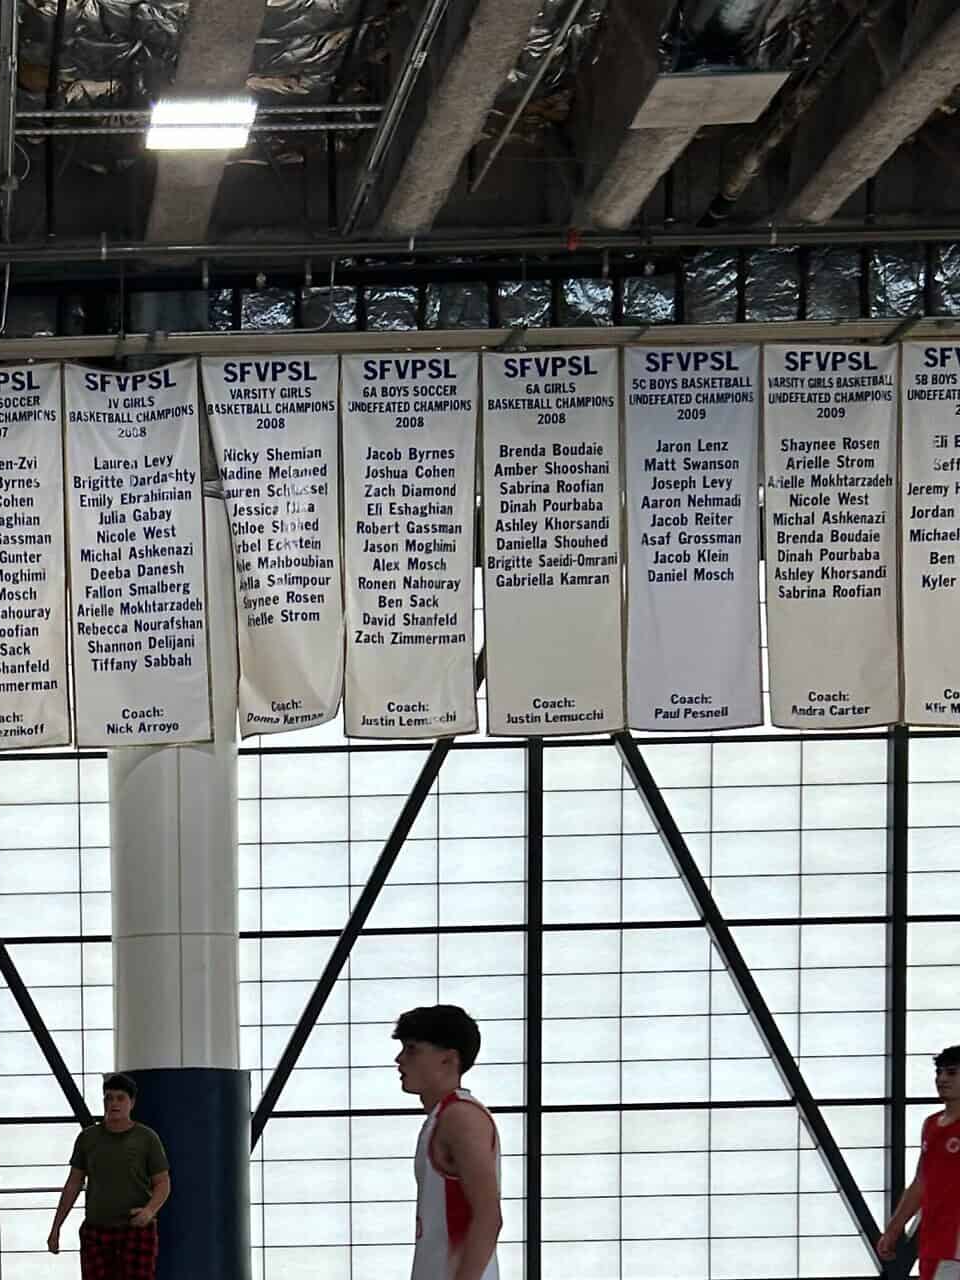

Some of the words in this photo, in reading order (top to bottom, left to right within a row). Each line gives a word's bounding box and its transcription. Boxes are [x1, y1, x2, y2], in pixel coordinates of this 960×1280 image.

[504, 356, 598, 378] SFVPSL
[646, 351, 738, 372] SFVPSL
[784, 352, 878, 371] SFVPSL
[224, 361, 317, 382] SFVPSL
[364, 359, 456, 380] SFVPSL
[85, 369, 176, 391] SFVPSL
[632, 379, 646, 389] 5C
[650, 378, 678, 390] BOYS
[682, 377, 752, 389] BASKETBALL
[915, 374, 928, 385] 5B
[932, 374, 957, 384] BOYS
[230, 388, 276, 399] VARSITY
[280, 387, 311, 398] GIRLS
[363, 387, 377, 397] 6A
[381, 386, 409, 397] BOYS
[413, 385, 456, 396] SOCCER
[526, 384, 540, 394] 6A
[544, 382, 576, 394] GIRLS
[123, 396, 154, 408] GIRLS
[488, 399, 552, 410] BASKETBALL
[556, 396, 614, 408] CHAMPIONS
[629, 394, 692, 405] UNDEFEATED
[695, 392, 754, 404] CHAMPIONS
[538, 413, 566, 424] 2008
[677, 409, 706, 420] 2009
[817, 407, 845, 418] 2009
[256, 418, 285, 429] 2008
[396, 417, 424, 428] 2008
[656, 440, 691, 452] Jaron
[698, 439, 728, 452] Lenz
[781, 439, 836, 453] Shaynee
[843, 437, 879, 449] Rosen
[224, 449, 259, 463] Nicky
[267, 448, 321, 461] Shemian
[366, 447, 401, 460] Jacob
[409, 448, 454, 462] Byrnes
[494, 463, 538, 476] Amber
[545, 461, 609, 474] Shooshani
[645, 458, 676, 471] Matt
[684, 458, 739, 470] Swanson
[364, 484, 395, 497] Zach
[402, 484, 456, 497] Diamond
[907, 483, 949, 497] Jeremy
[500, 500, 536, 513] Dinah
[544, 498, 602, 511] Pourbaba
[910, 505, 954, 518] Jordan
[773, 512, 814, 525] Michal
[822, 511, 885, 524] Ashkenazi
[97, 529, 136, 543] Nicole
[143, 525, 176, 539] West
[373, 558, 399, 571] Alex
[408, 558, 446, 570] Mosch
[930, 552, 954, 564] Ben
[91, 567, 130, 580] Deeba
[138, 562, 184, 577] Danesh
[775, 568, 814, 582] Ashley
[821, 566, 886, 579] Khorsandi
[496, 573, 554, 587] Gabriella
[561, 573, 609, 585] Kamran
[922, 575, 956, 590] Kyler
[91, 658, 137, 672] Tiffany
[144, 653, 191, 667] Sabbah
[670, 694, 712, 704] Coach:
[808, 691, 849, 702] Coach:
[388, 702, 429, 712] Coach:
[533, 698, 575, 709] Coach:
[926, 703, 947, 712] Kfir
[122, 707, 163, 719] Coach:
[506, 713, 541, 724] Justin
[545, 710, 604, 723] Lemucchi
[655, 708, 680, 719] Paul
[684, 707, 728, 718] Pesnell
[792, 705, 825, 716] Andra
[829, 705, 870, 715] Carter
[107, 723, 133, 734] Nick
[138, 722, 179, 733] Arroyo
